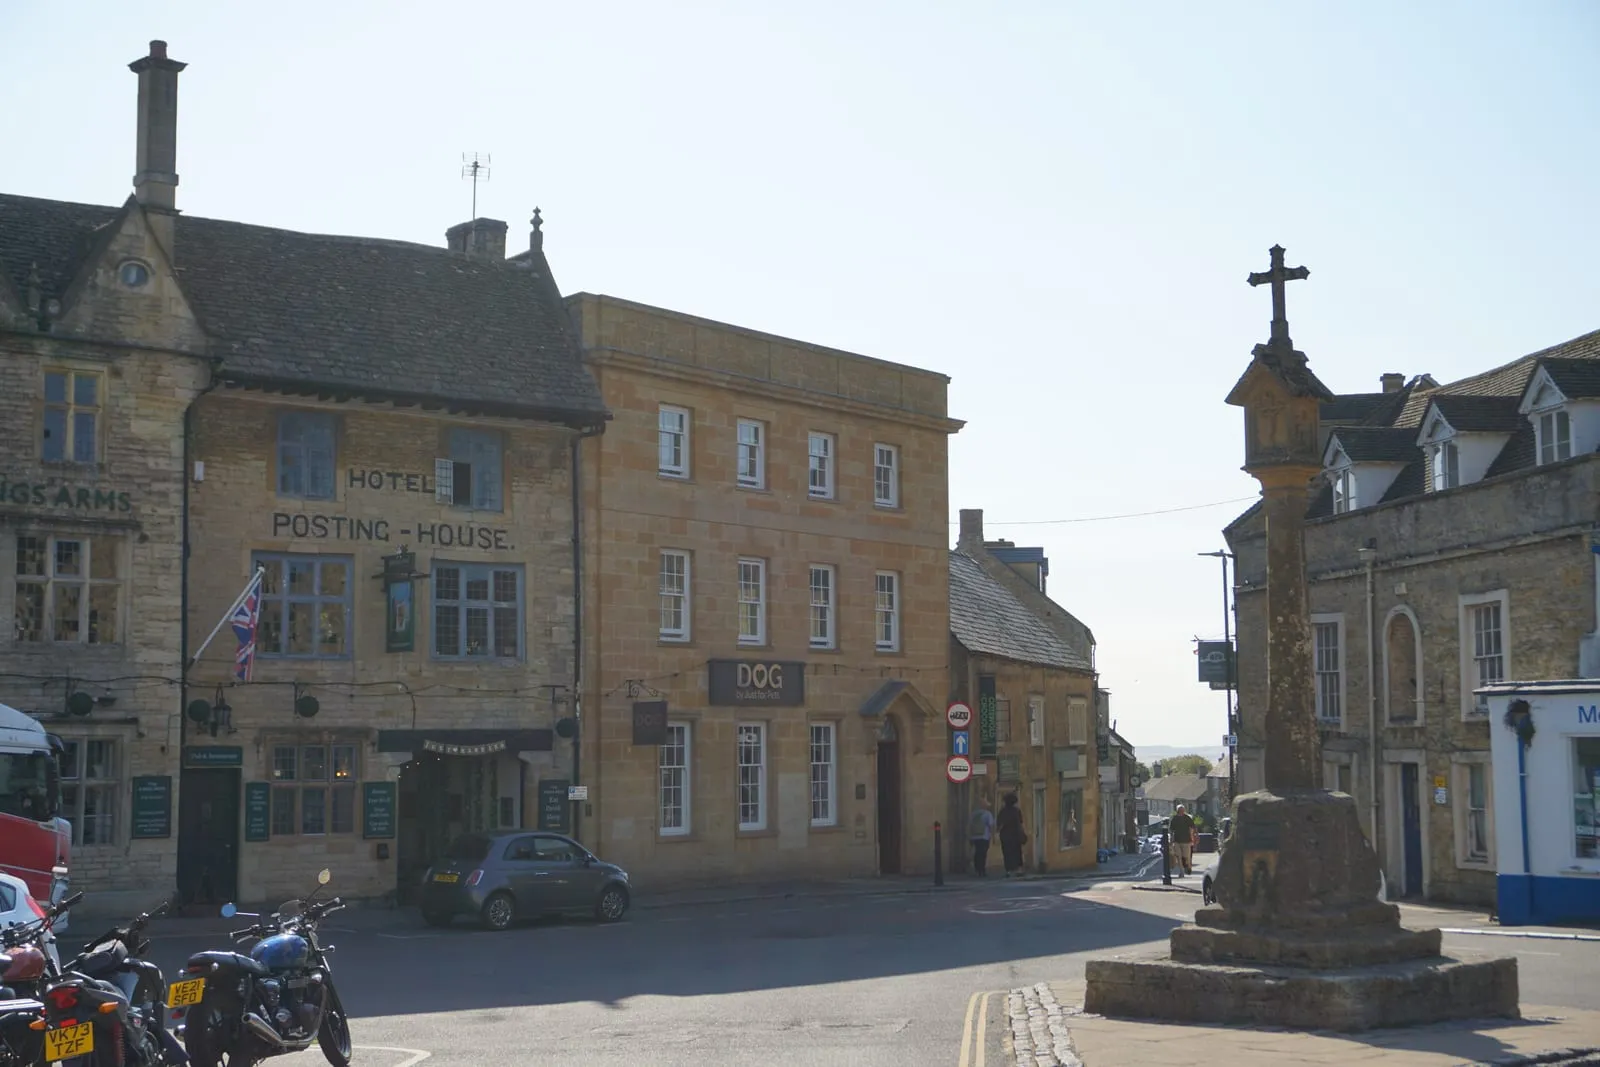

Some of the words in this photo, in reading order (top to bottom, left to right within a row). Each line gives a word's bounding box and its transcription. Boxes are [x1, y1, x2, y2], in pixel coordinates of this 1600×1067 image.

[348, 469, 437, 495] HOTEL
[54, 485, 131, 512] ARMS
[272, 512, 390, 542] POSTING
[736, 663, 784, 689] DOG
[48, 1023, 91, 1044] VK73
[54, 1037, 86, 1056] TZF
